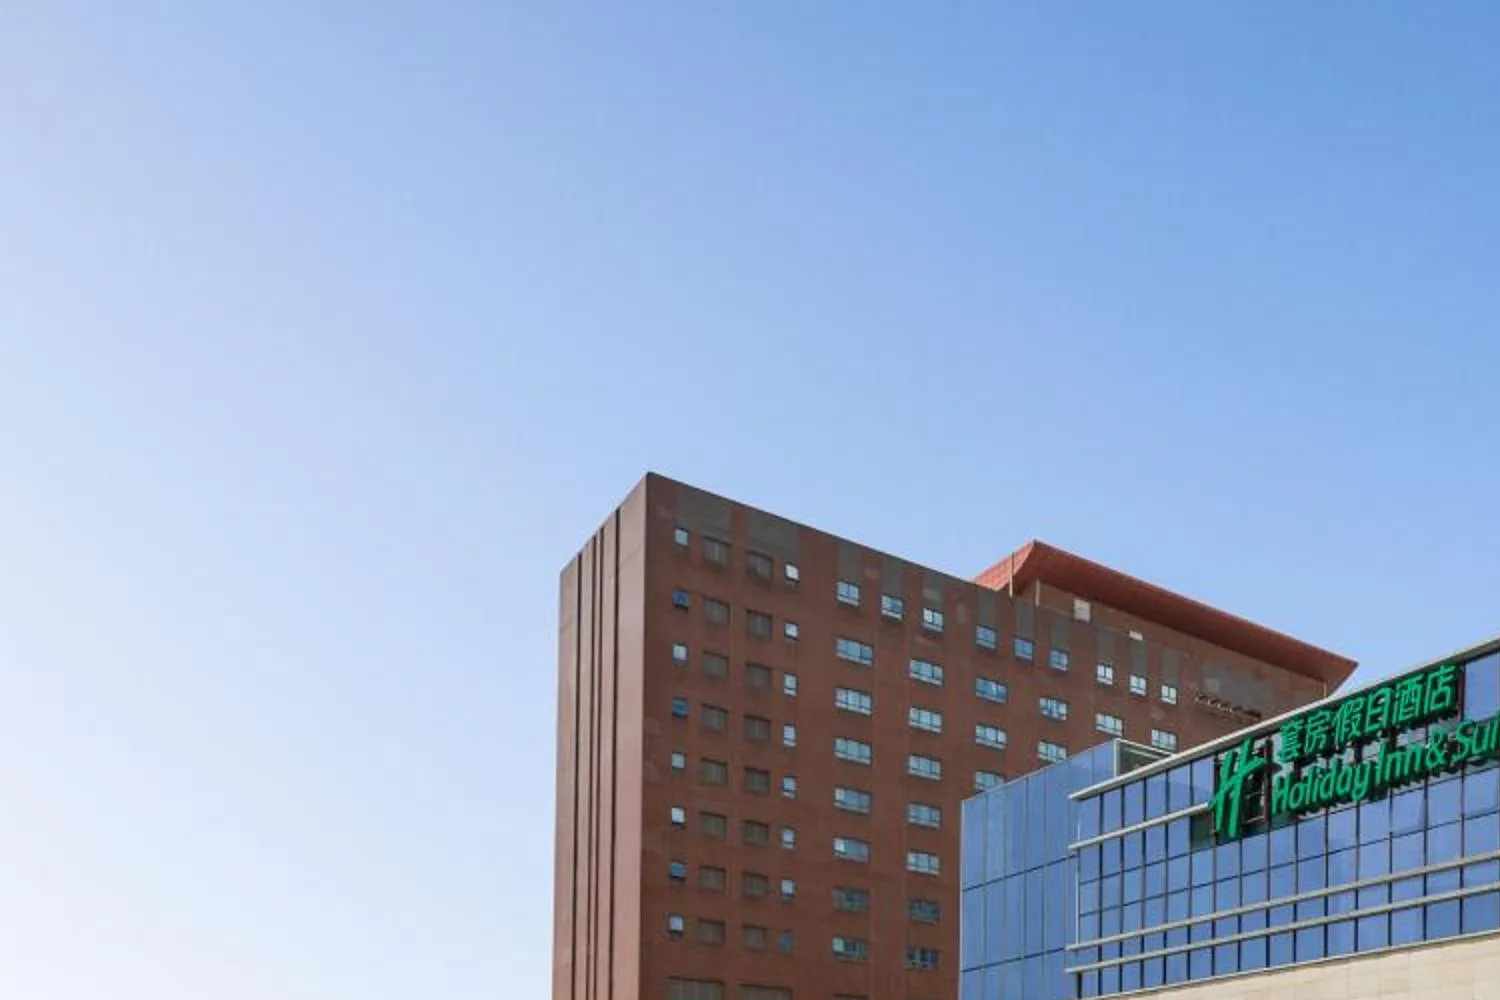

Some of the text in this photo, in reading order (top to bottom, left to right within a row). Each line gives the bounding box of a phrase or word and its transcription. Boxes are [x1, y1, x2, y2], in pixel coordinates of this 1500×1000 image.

[1279, 665, 1456, 762] 套房假日酒店
[1272, 758, 1371, 815] Holiday
